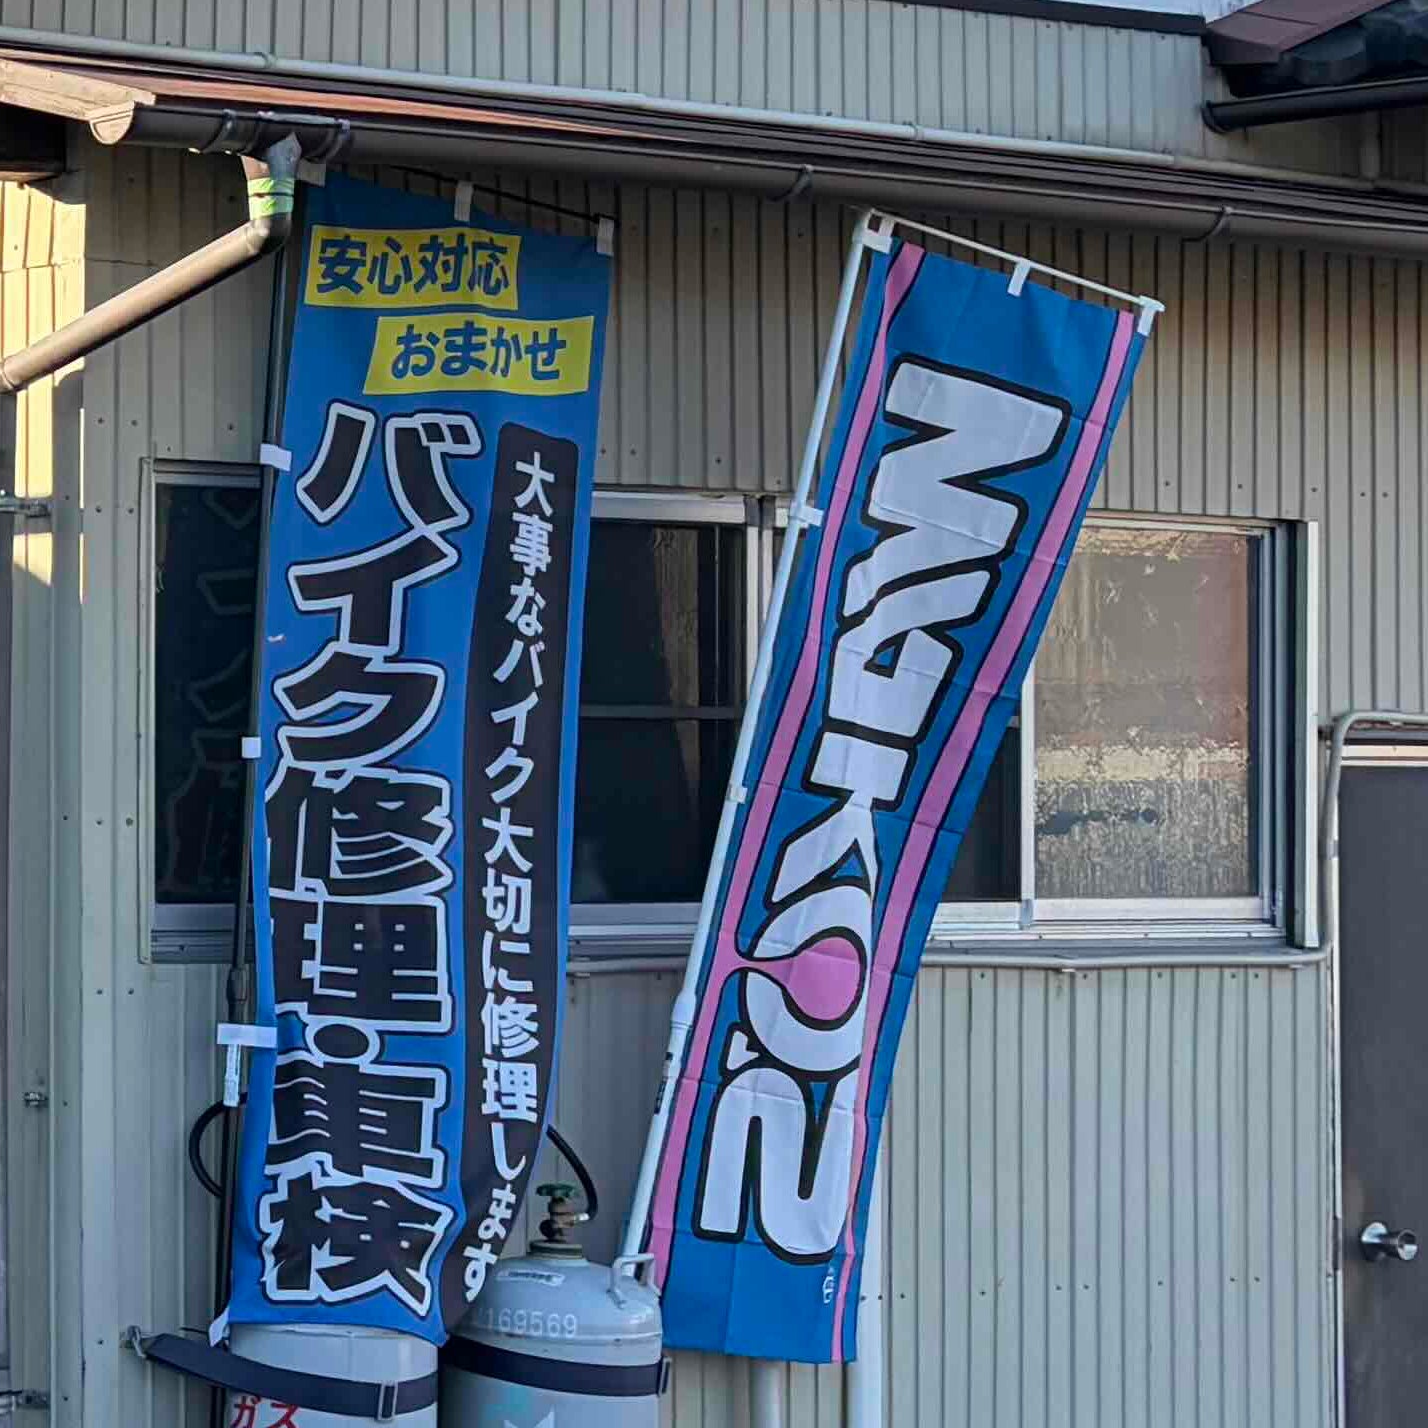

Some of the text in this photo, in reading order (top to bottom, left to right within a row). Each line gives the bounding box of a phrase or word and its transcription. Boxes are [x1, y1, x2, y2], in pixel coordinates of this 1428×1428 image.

[316, 233, 510, 297] 安心対応
[390, 320, 567, 382] おまかせ
[462, 451, 556, 1303] 大事なバイク大切に修理します
